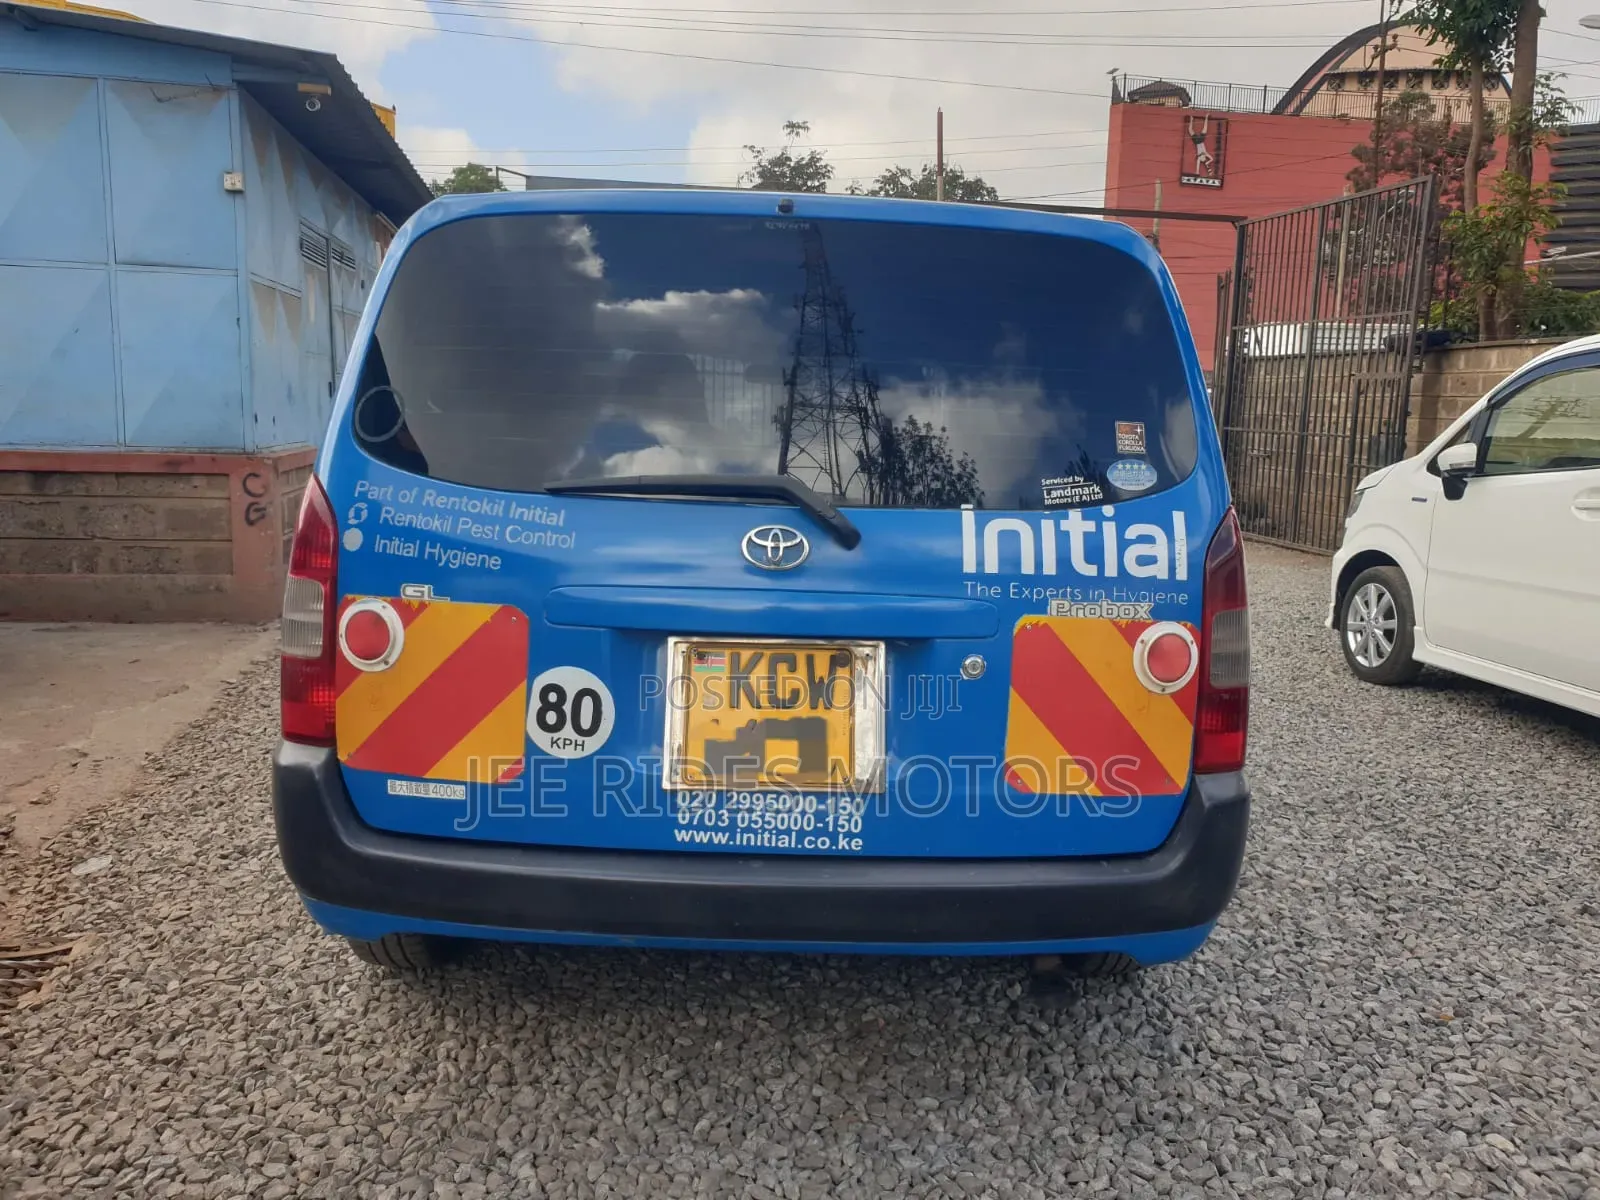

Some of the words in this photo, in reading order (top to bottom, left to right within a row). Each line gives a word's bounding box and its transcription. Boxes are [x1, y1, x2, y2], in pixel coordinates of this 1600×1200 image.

[1041, 476, 1073, 486] Serviced
[1074, 475, 1084, 484] by
[1043, 483, 1101, 499] Landmark
[354, 480, 392, 501] Part
[398, 486, 418, 504] of
[422, 490, 504, 518] Rentokil
[509, 503, 565, 527] Initial
[1044, 497, 1072, 506] Motors
[1091, 492, 1103, 501] Ltd
[379, 506, 453, 533] Rentokil
[457, 518, 500, 541] Pest
[505, 525, 576, 549] Control
[374, 534, 419, 559] Initial
[424, 543, 502, 570] Hygiene
[400, 583, 450, 601] GL
[964, 581, 1001, 598] The
[1009, 582, 1082, 602] Experts
[1089, 583, 1105, 601] in
[1113, 586, 1189, 606] Hygiene
[1048, 600, 1155, 621] Probox
[730, 651, 838, 710] KCW
[535, 683, 603, 738] 80
[550, 737, 585, 752] KPH
[676, 791, 717, 809] 020
[725, 792, 865, 816] 2995000-150
[677, 808, 729, 827] 0703
[736, 809, 863, 833] 055000-150
[674, 827, 863, 851] www.initial.co.ke
